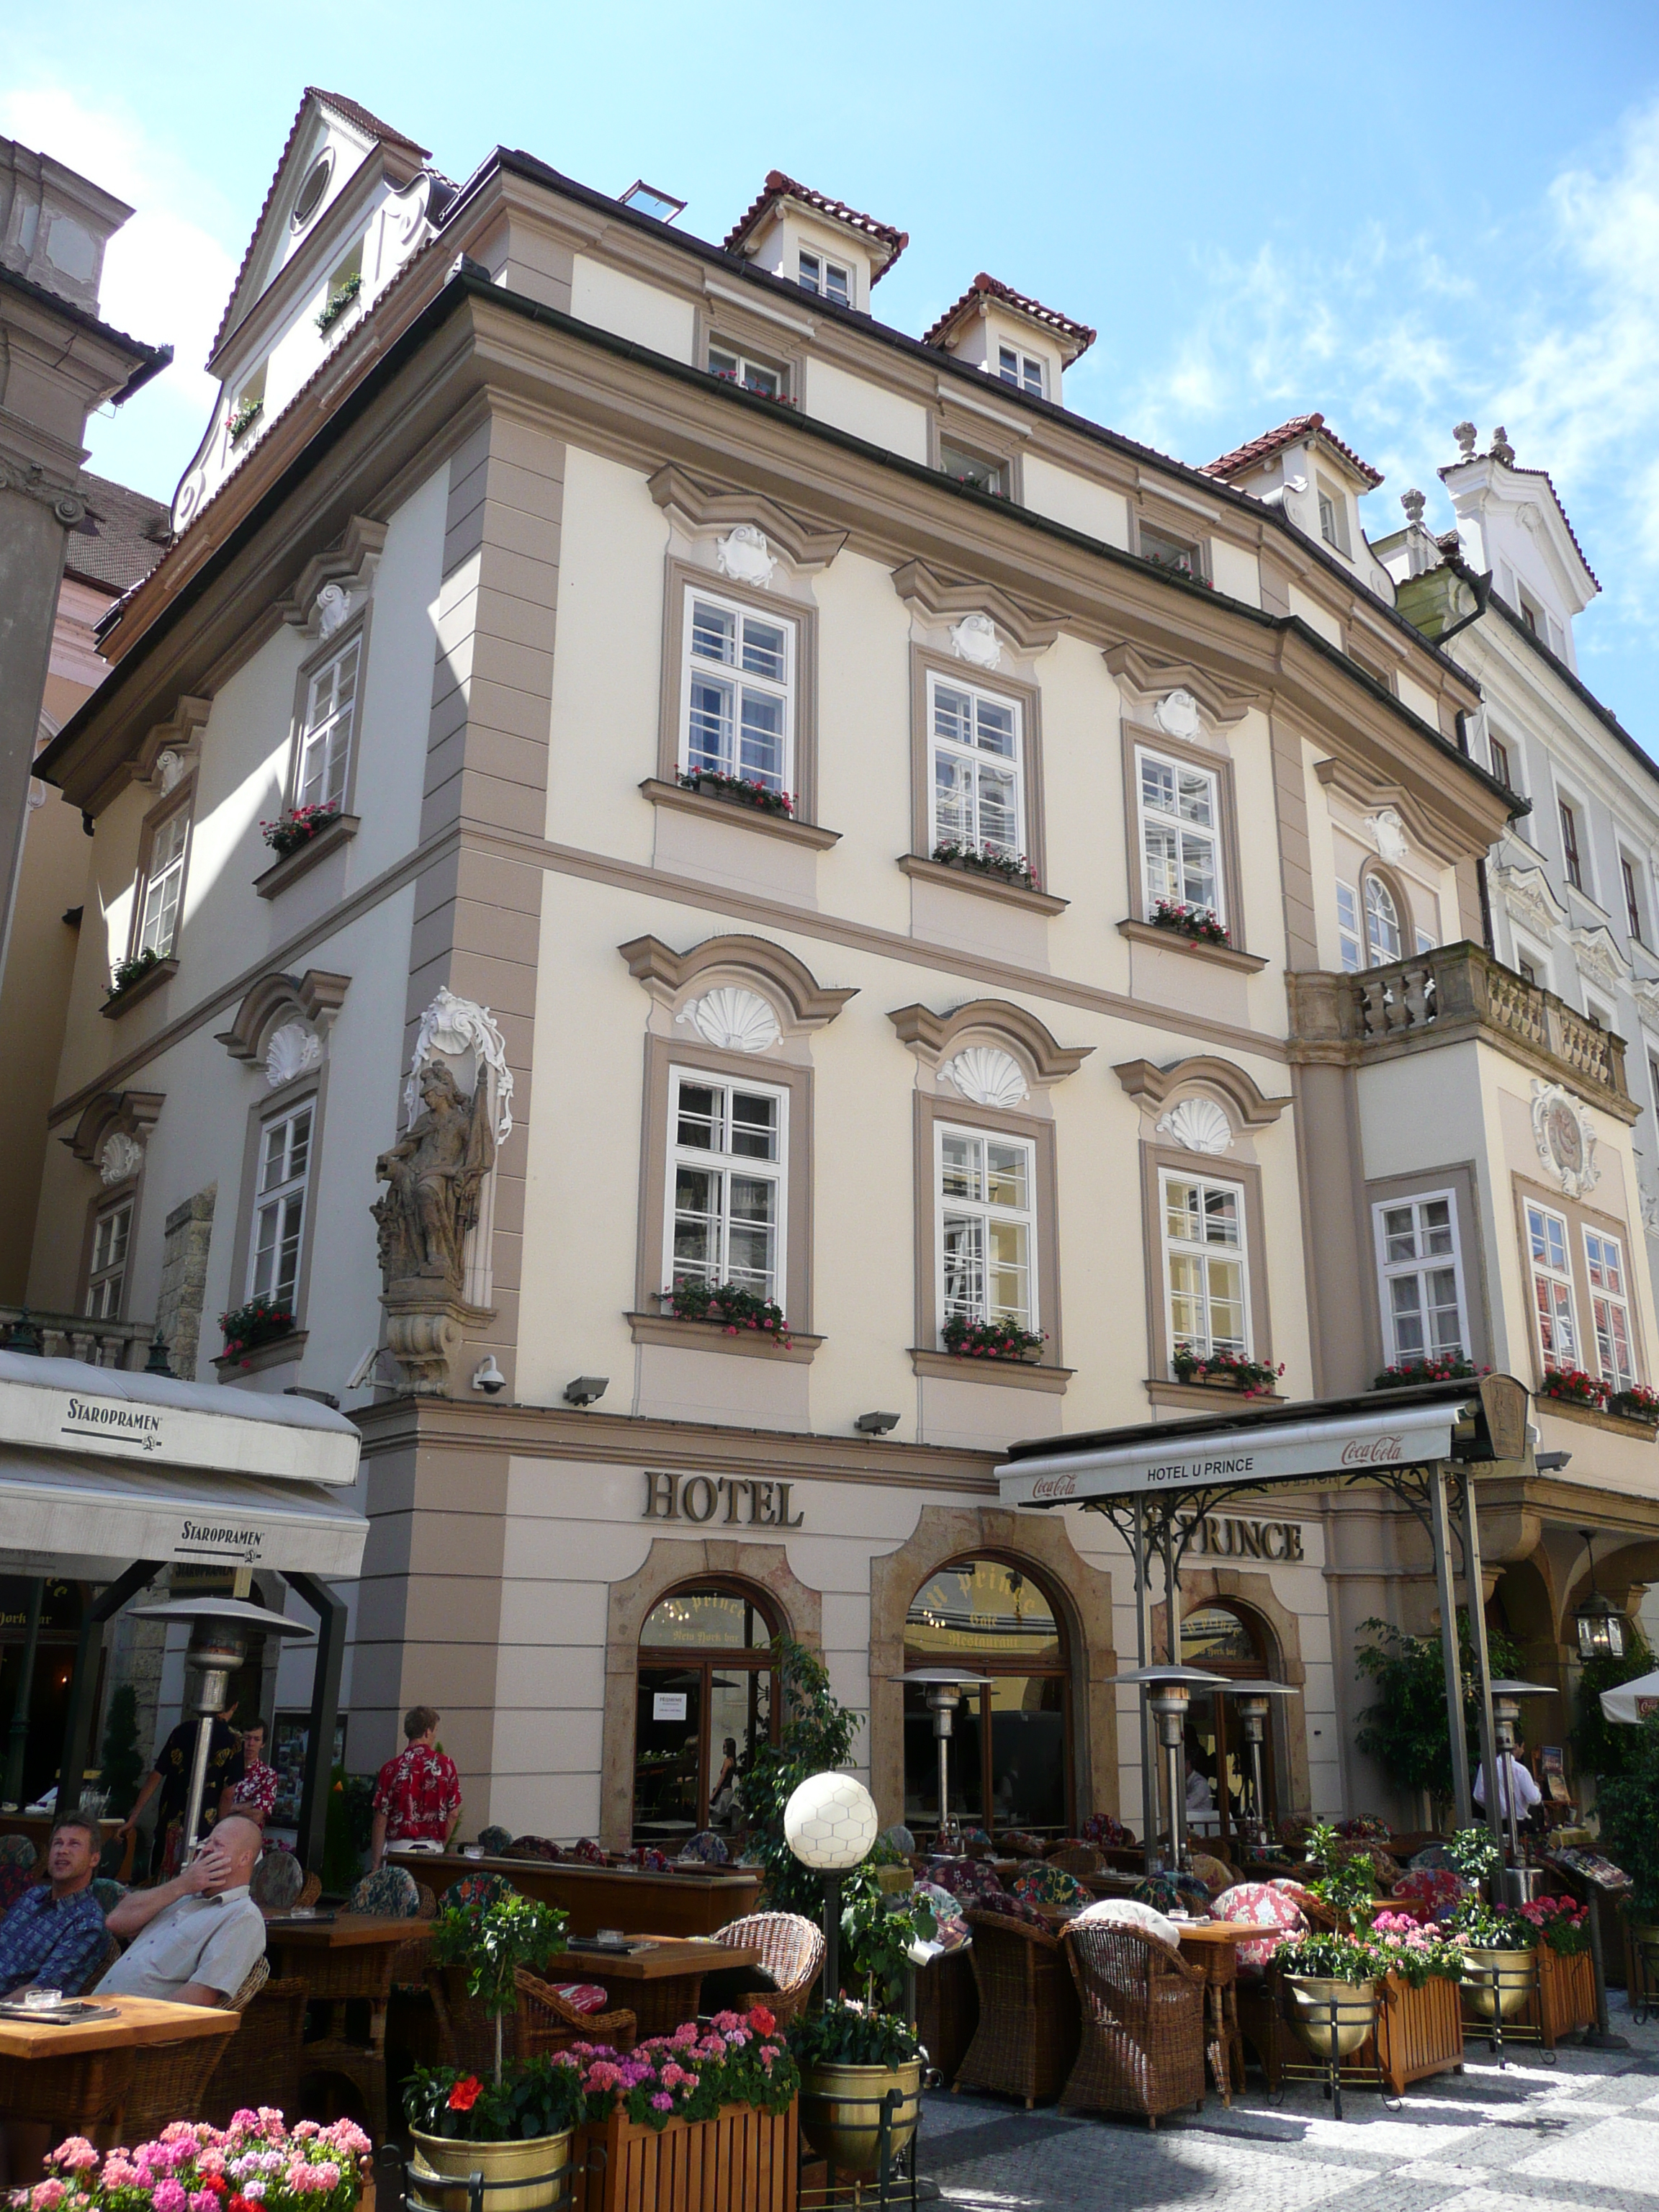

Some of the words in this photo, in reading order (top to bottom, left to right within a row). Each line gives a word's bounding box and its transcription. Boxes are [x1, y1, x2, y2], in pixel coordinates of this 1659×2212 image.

[67, 1398, 160, 1431] STAROPRAMEN
[1148, 1465, 1188, 1481] HOTEL
[1192, 1464, 1201, 1477] U
[1204, 1457, 1254, 1475] PRINCE
[642, 1471, 805, 1527] HOTEL
[1179, 1514, 1305, 1562] PRINCE
